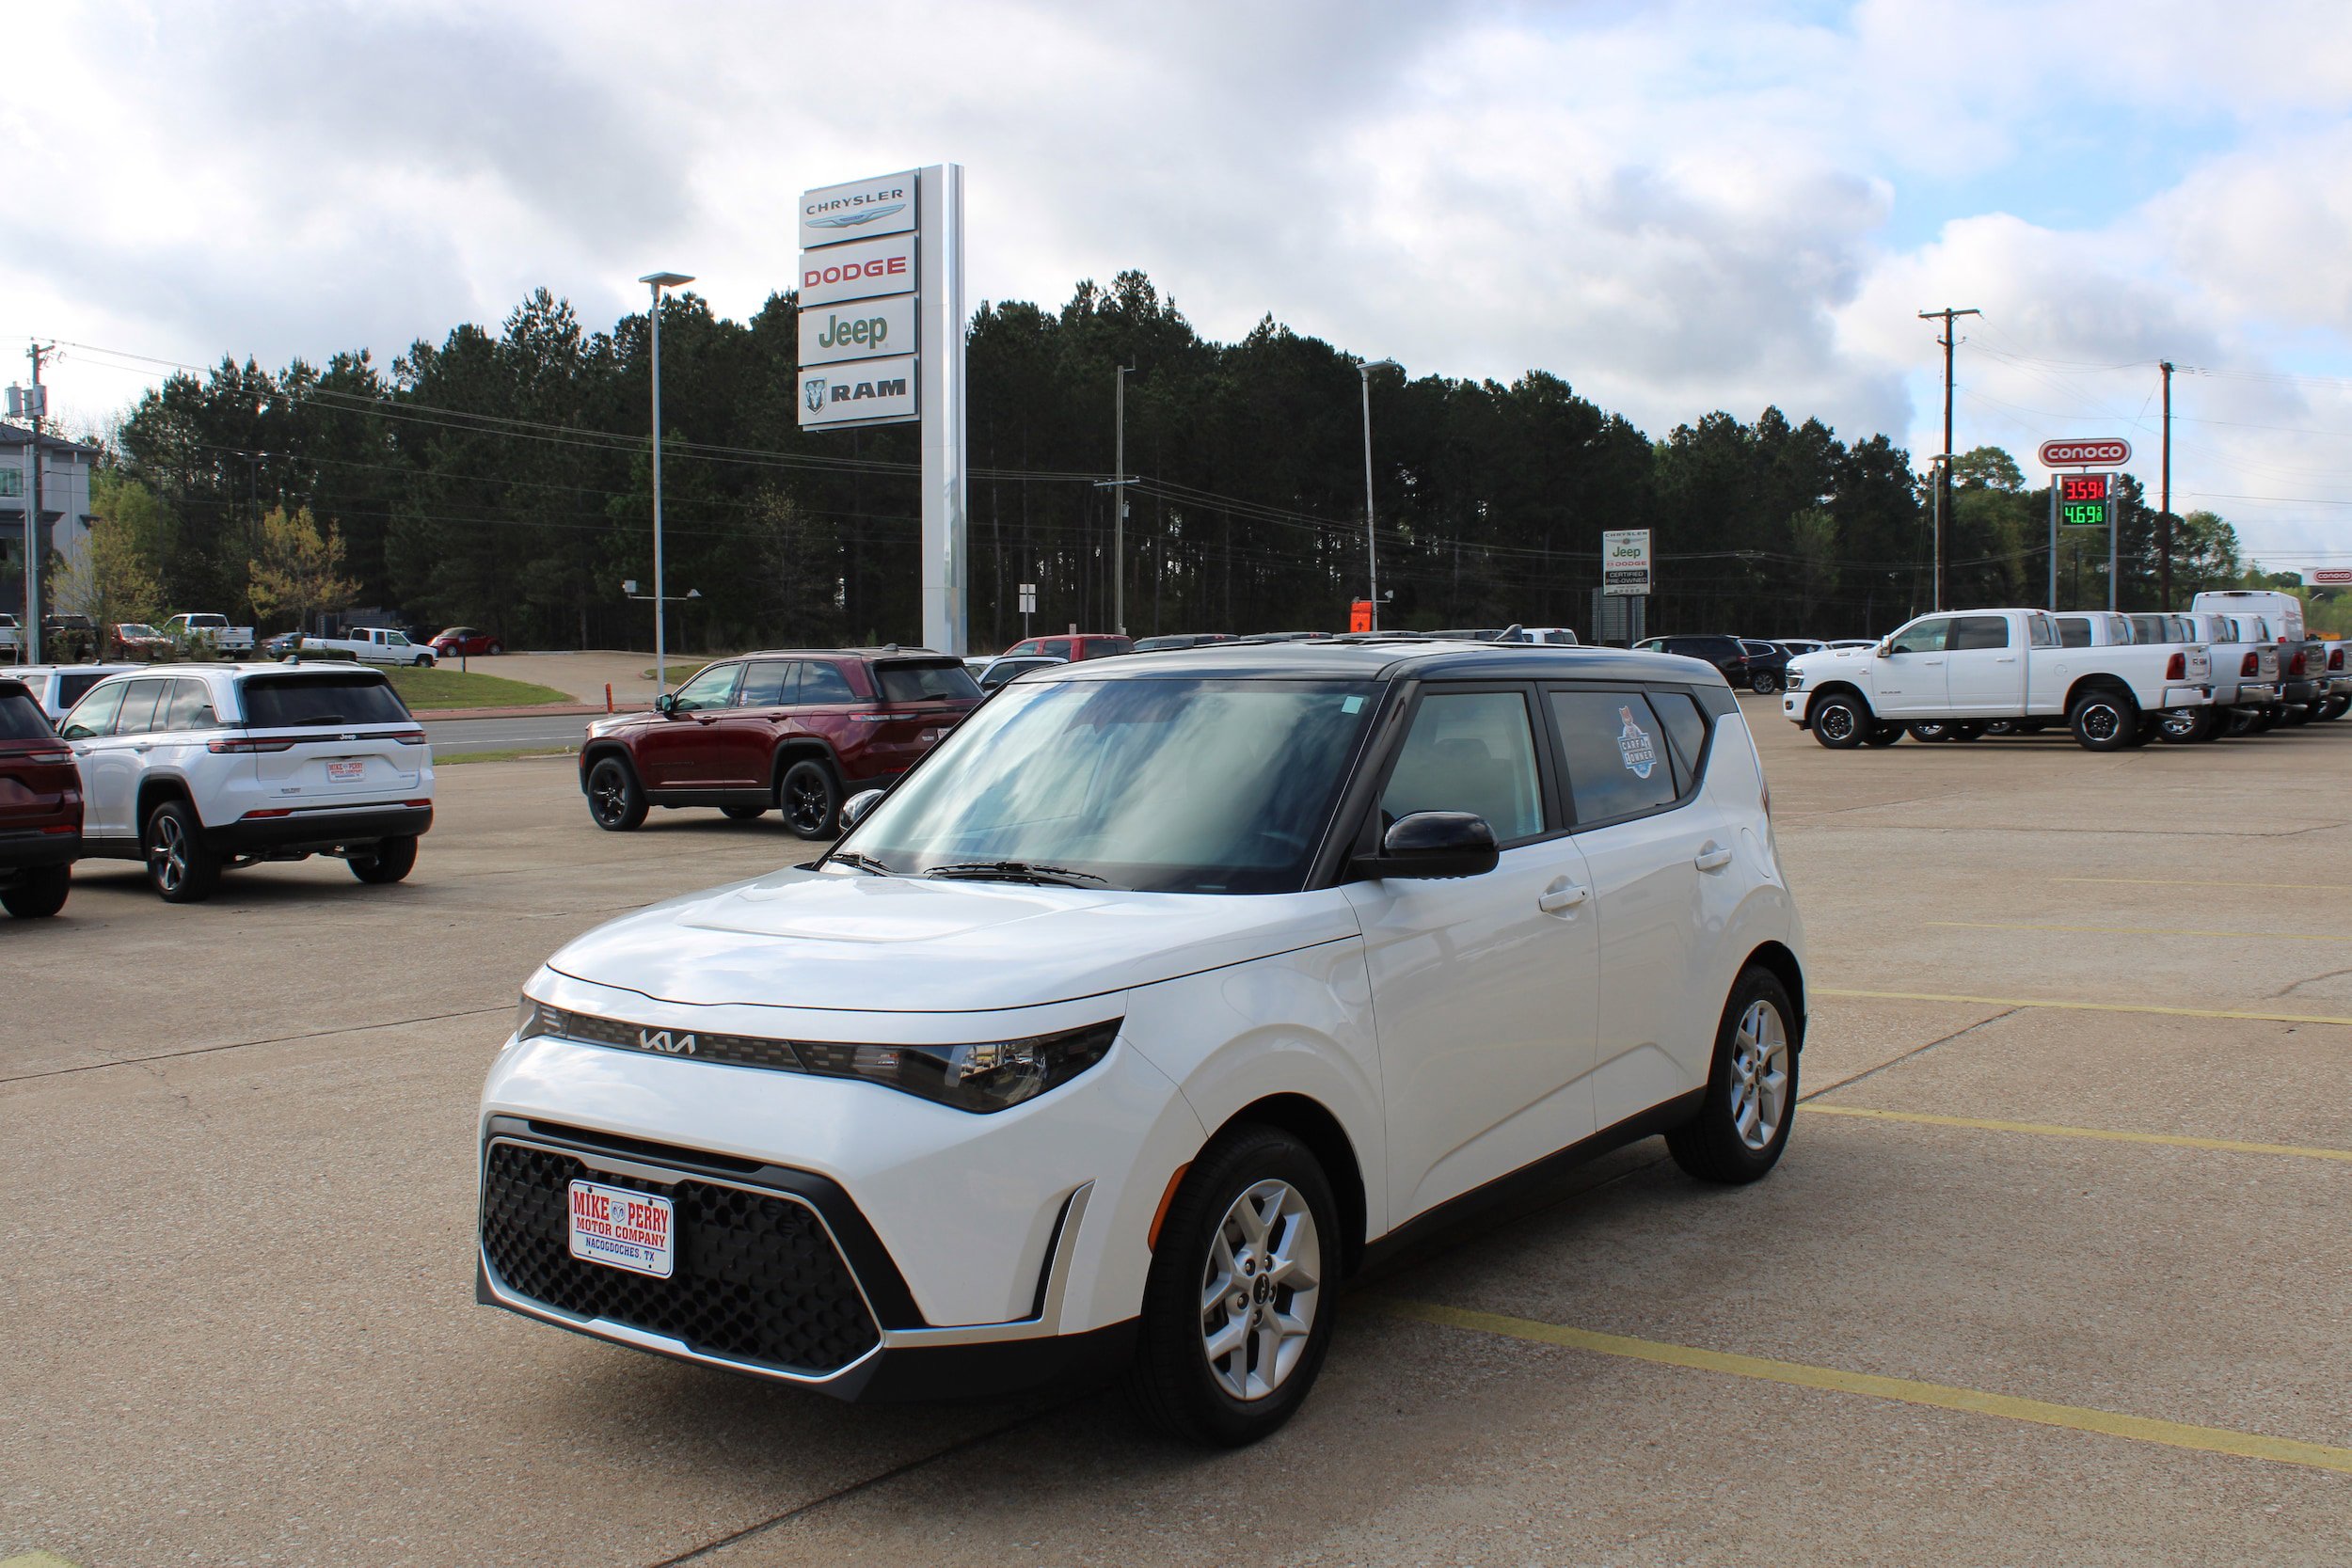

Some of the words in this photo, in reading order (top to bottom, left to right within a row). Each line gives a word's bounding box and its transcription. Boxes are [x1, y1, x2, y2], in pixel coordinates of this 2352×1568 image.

[806, 189, 903, 214] CHRYSLER
[804, 256, 906, 288] DODGE
[818, 315, 887, 349] Jeep
[831, 379, 906, 402] RAM
[1613, 546, 1641, 559] Jeep
[640, 1029, 695, 1054] KIA
[573, 1191, 610, 1221] MIKE
[628, 1202, 668, 1233] PERRY
[577, 1217, 612, 1236] MOTOR
[615, 1226, 665, 1248] COMPANY
[586, 1237, 642, 1259] NACOGDOCHES,
[644, 1250, 655, 1261] TX
